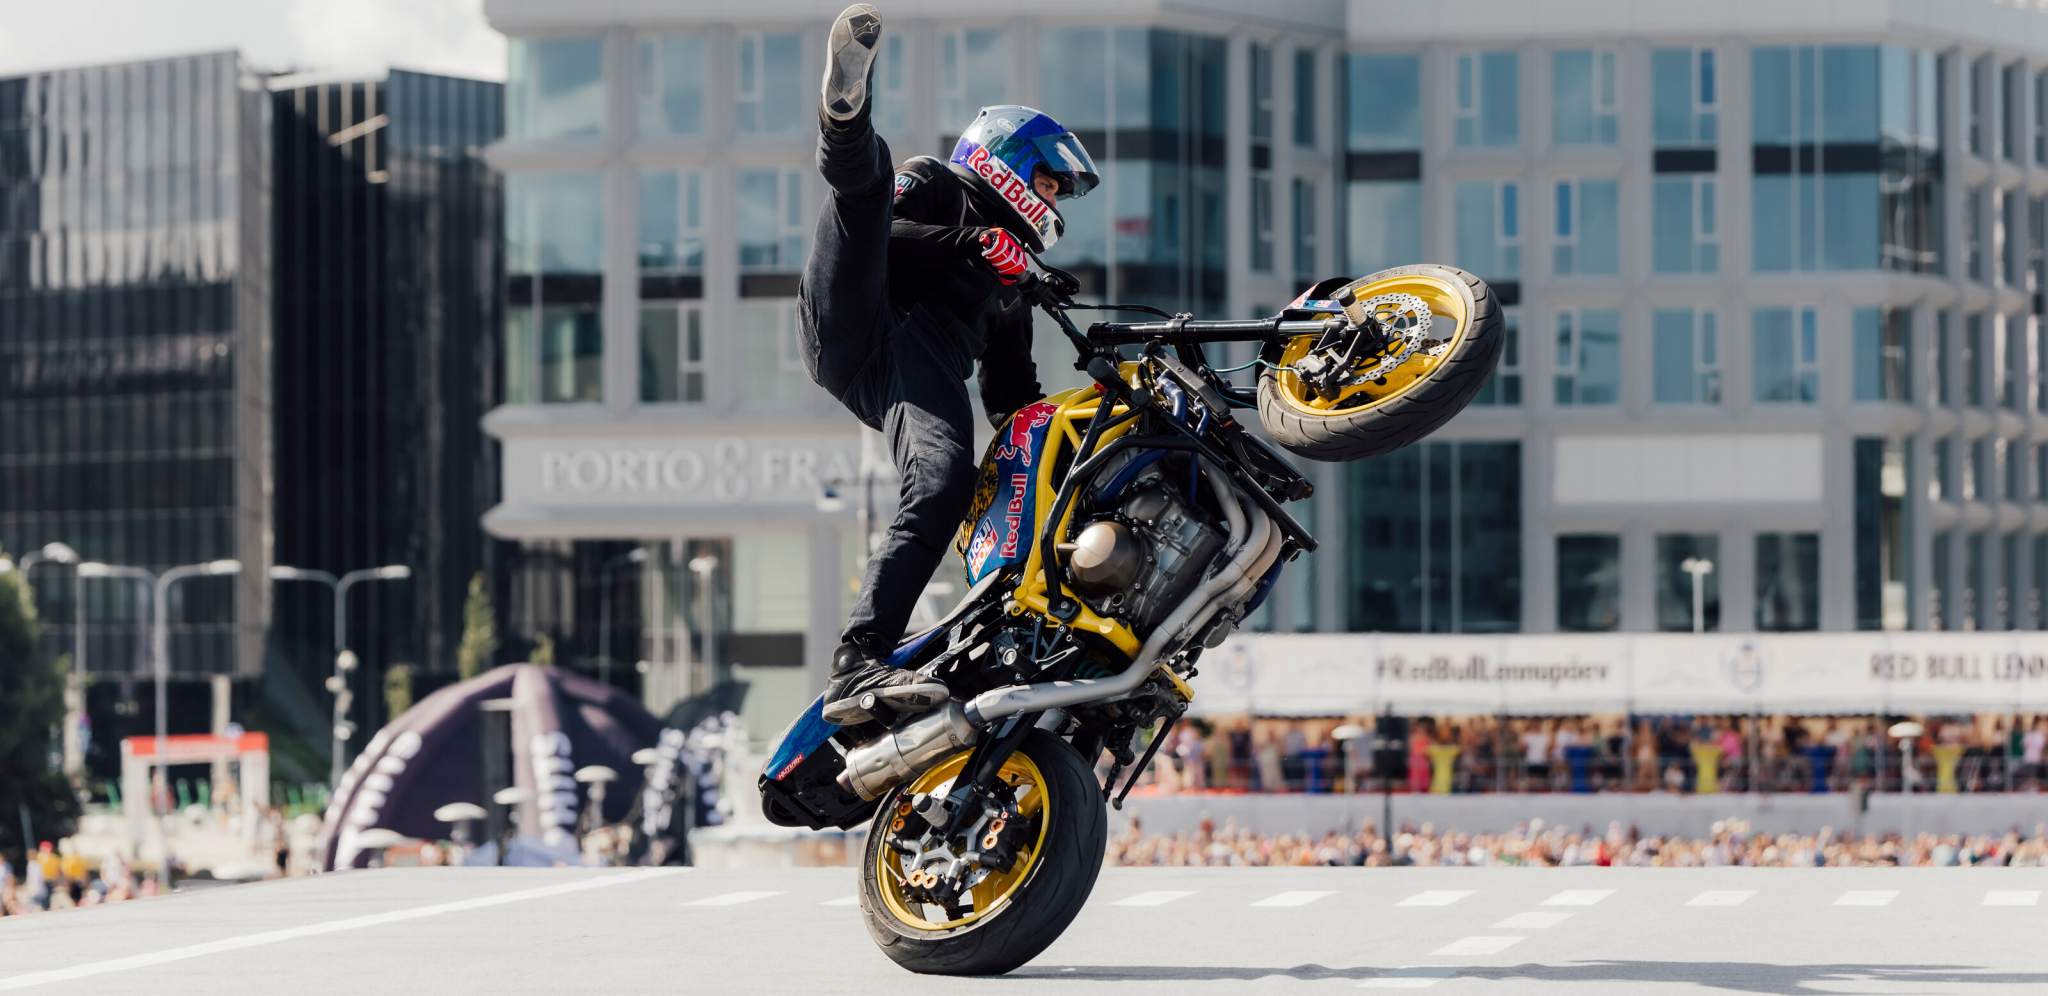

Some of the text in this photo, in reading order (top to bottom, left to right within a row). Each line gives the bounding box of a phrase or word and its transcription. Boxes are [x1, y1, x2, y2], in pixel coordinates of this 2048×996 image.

[967, 147, 1049, 225] Red Bull
[542, 448, 707, 493] PORTO
[761, 449, 862, 491] FRA
[1000, 474, 1028, 558] Red Bull
[968, 521, 992, 567] LIQUI
[972, 530, 995, 578] MOLY
[1871, 653, 1917, 679] RED
[1926, 653, 1981, 680] BULL
